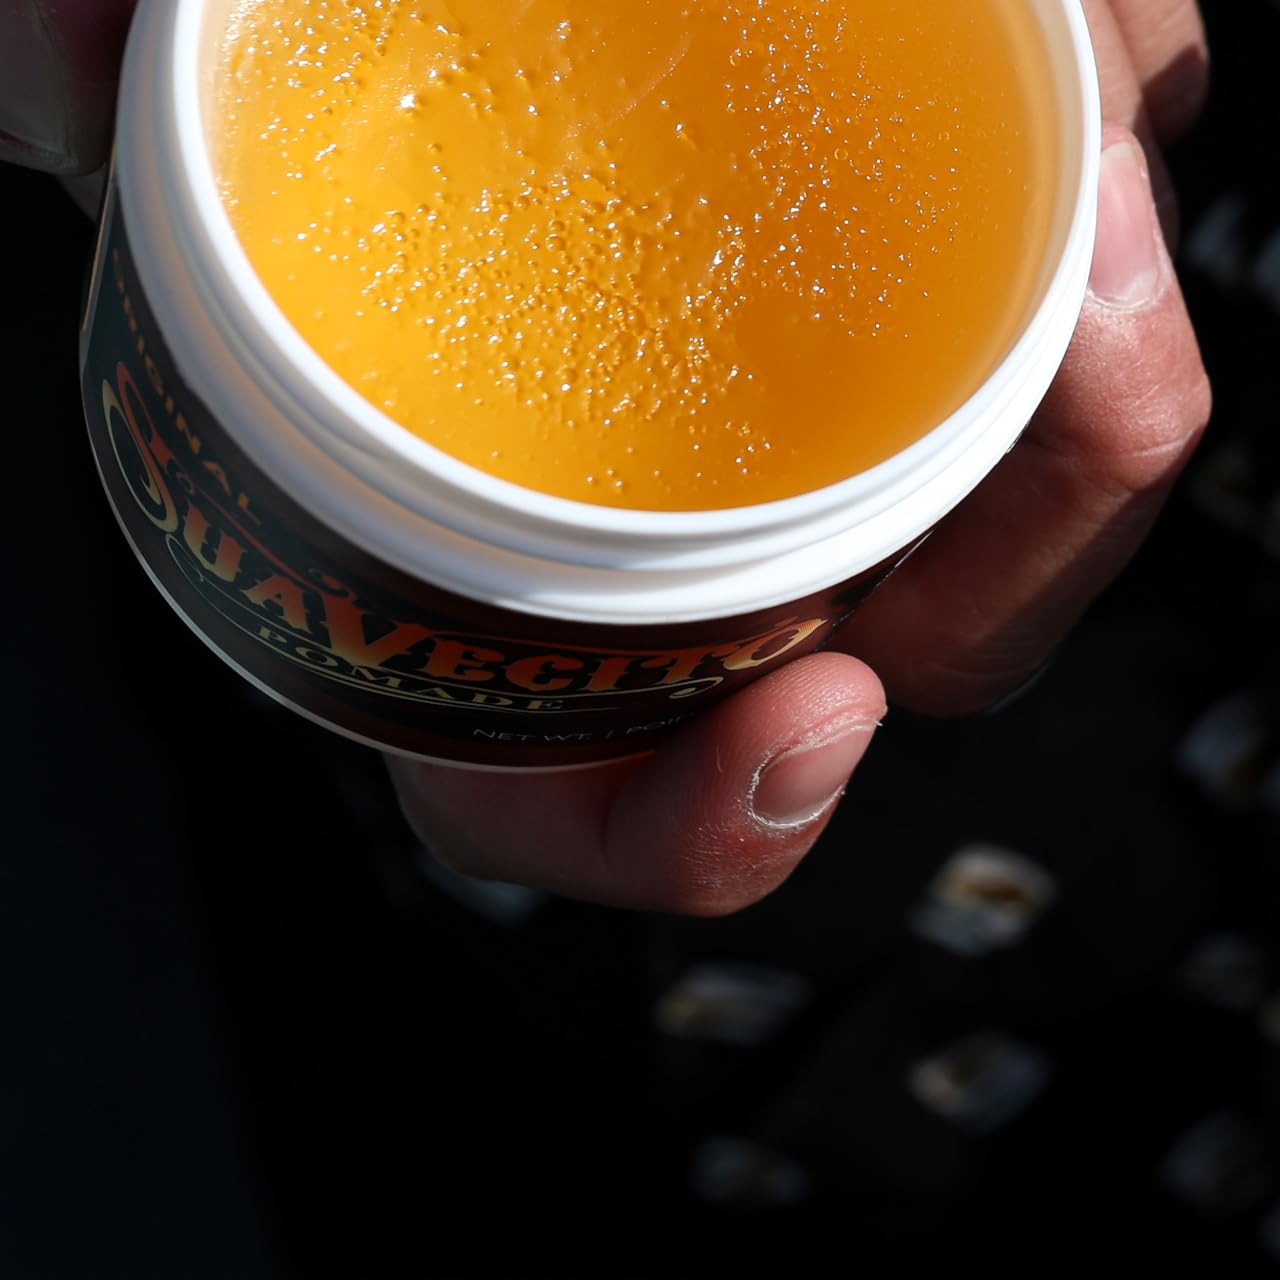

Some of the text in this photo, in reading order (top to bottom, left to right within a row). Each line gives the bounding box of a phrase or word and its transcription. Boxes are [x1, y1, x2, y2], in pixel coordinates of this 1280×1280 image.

[102, 361, 828, 692] SUAVECITO
[259, 626, 566, 712] POMADE
[473, 727, 532, 744] NET
